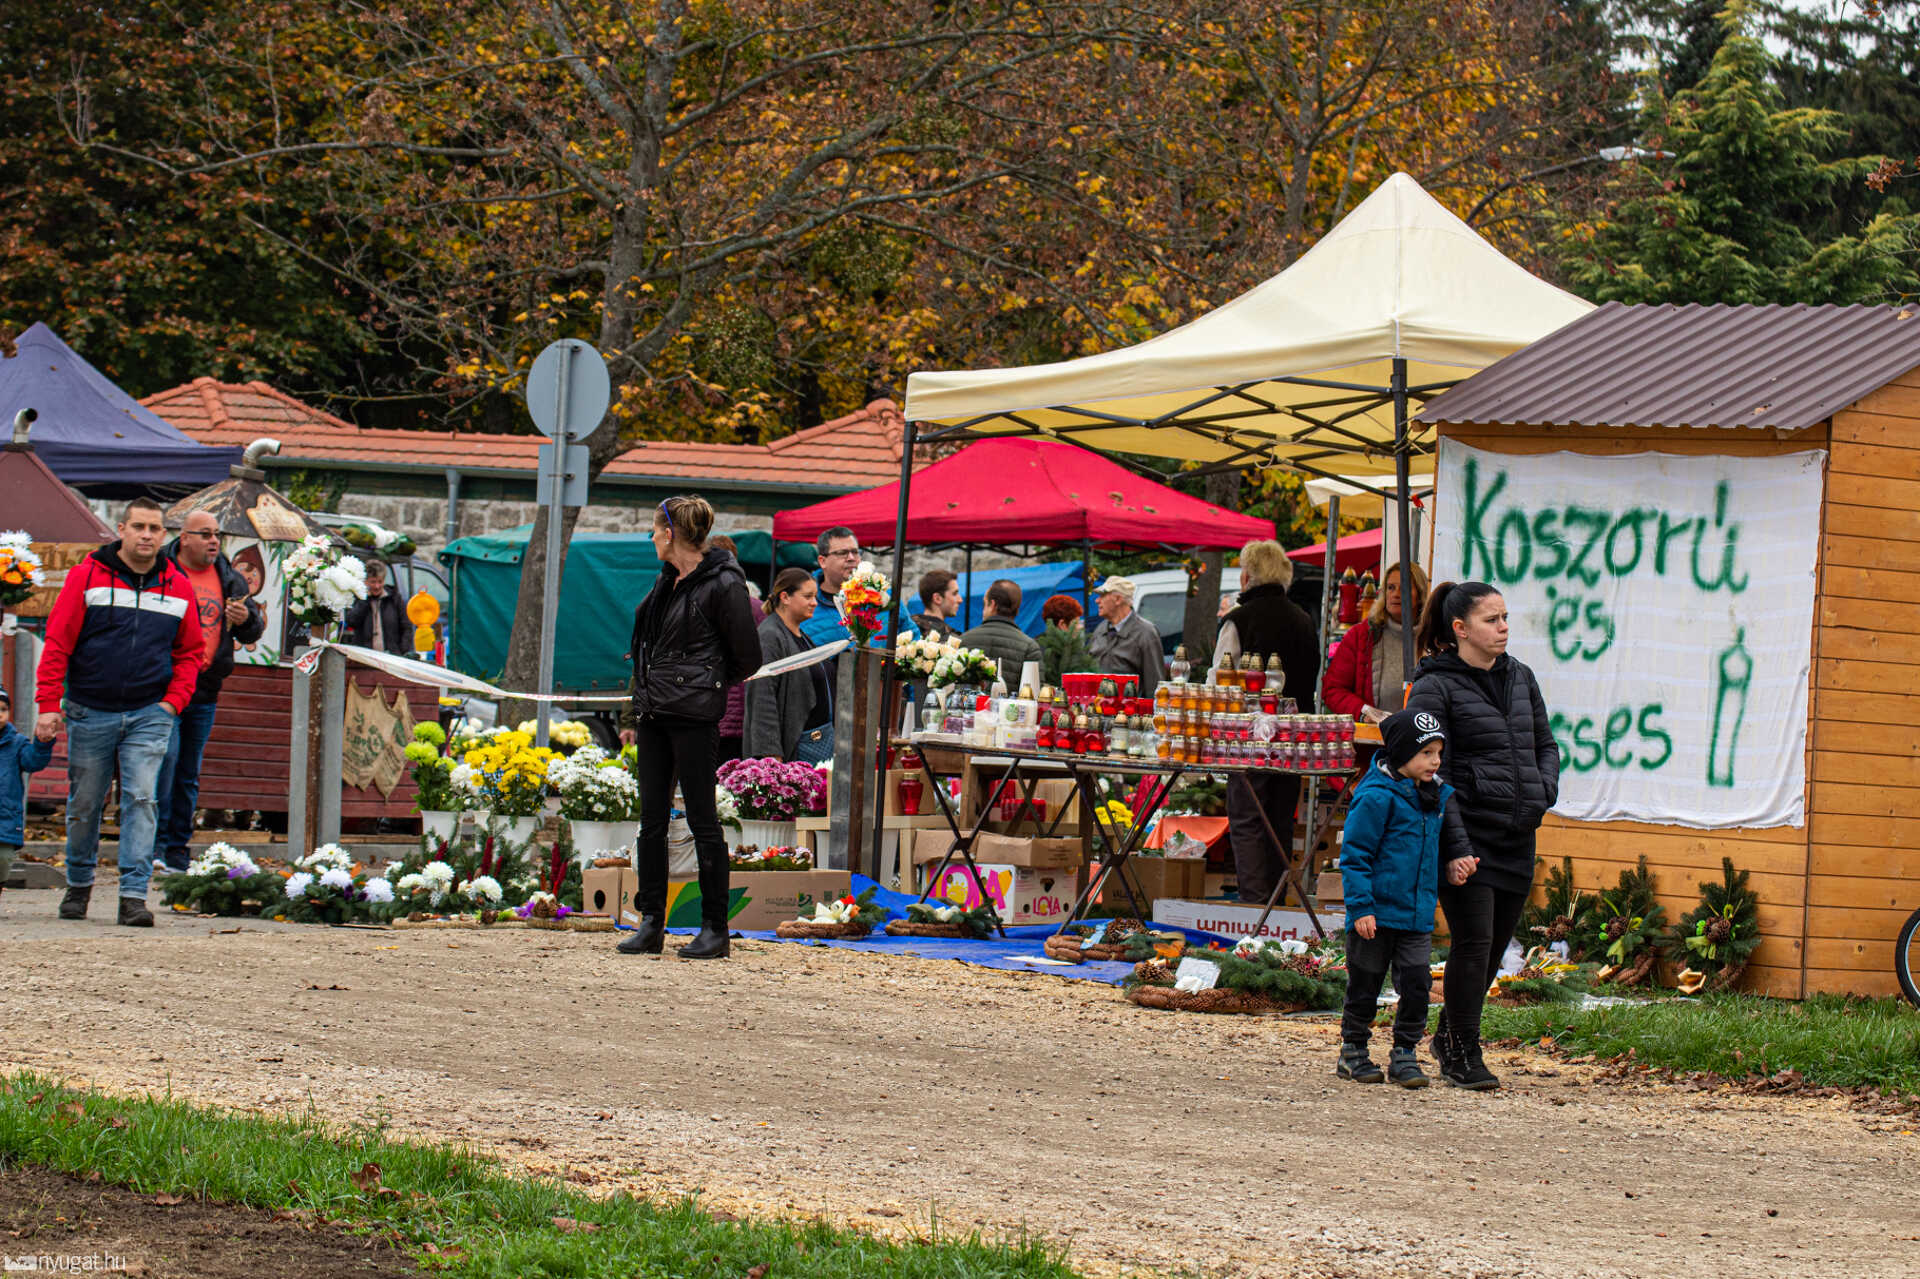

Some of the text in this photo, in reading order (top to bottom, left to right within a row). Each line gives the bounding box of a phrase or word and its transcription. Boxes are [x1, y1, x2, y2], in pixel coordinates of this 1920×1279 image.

[1461, 458, 1749, 593] Koszorú
[1547, 585, 1615, 661] és
[1033, 896, 1061, 916] LOLA
[1196, 918, 1297, 942] Premium
